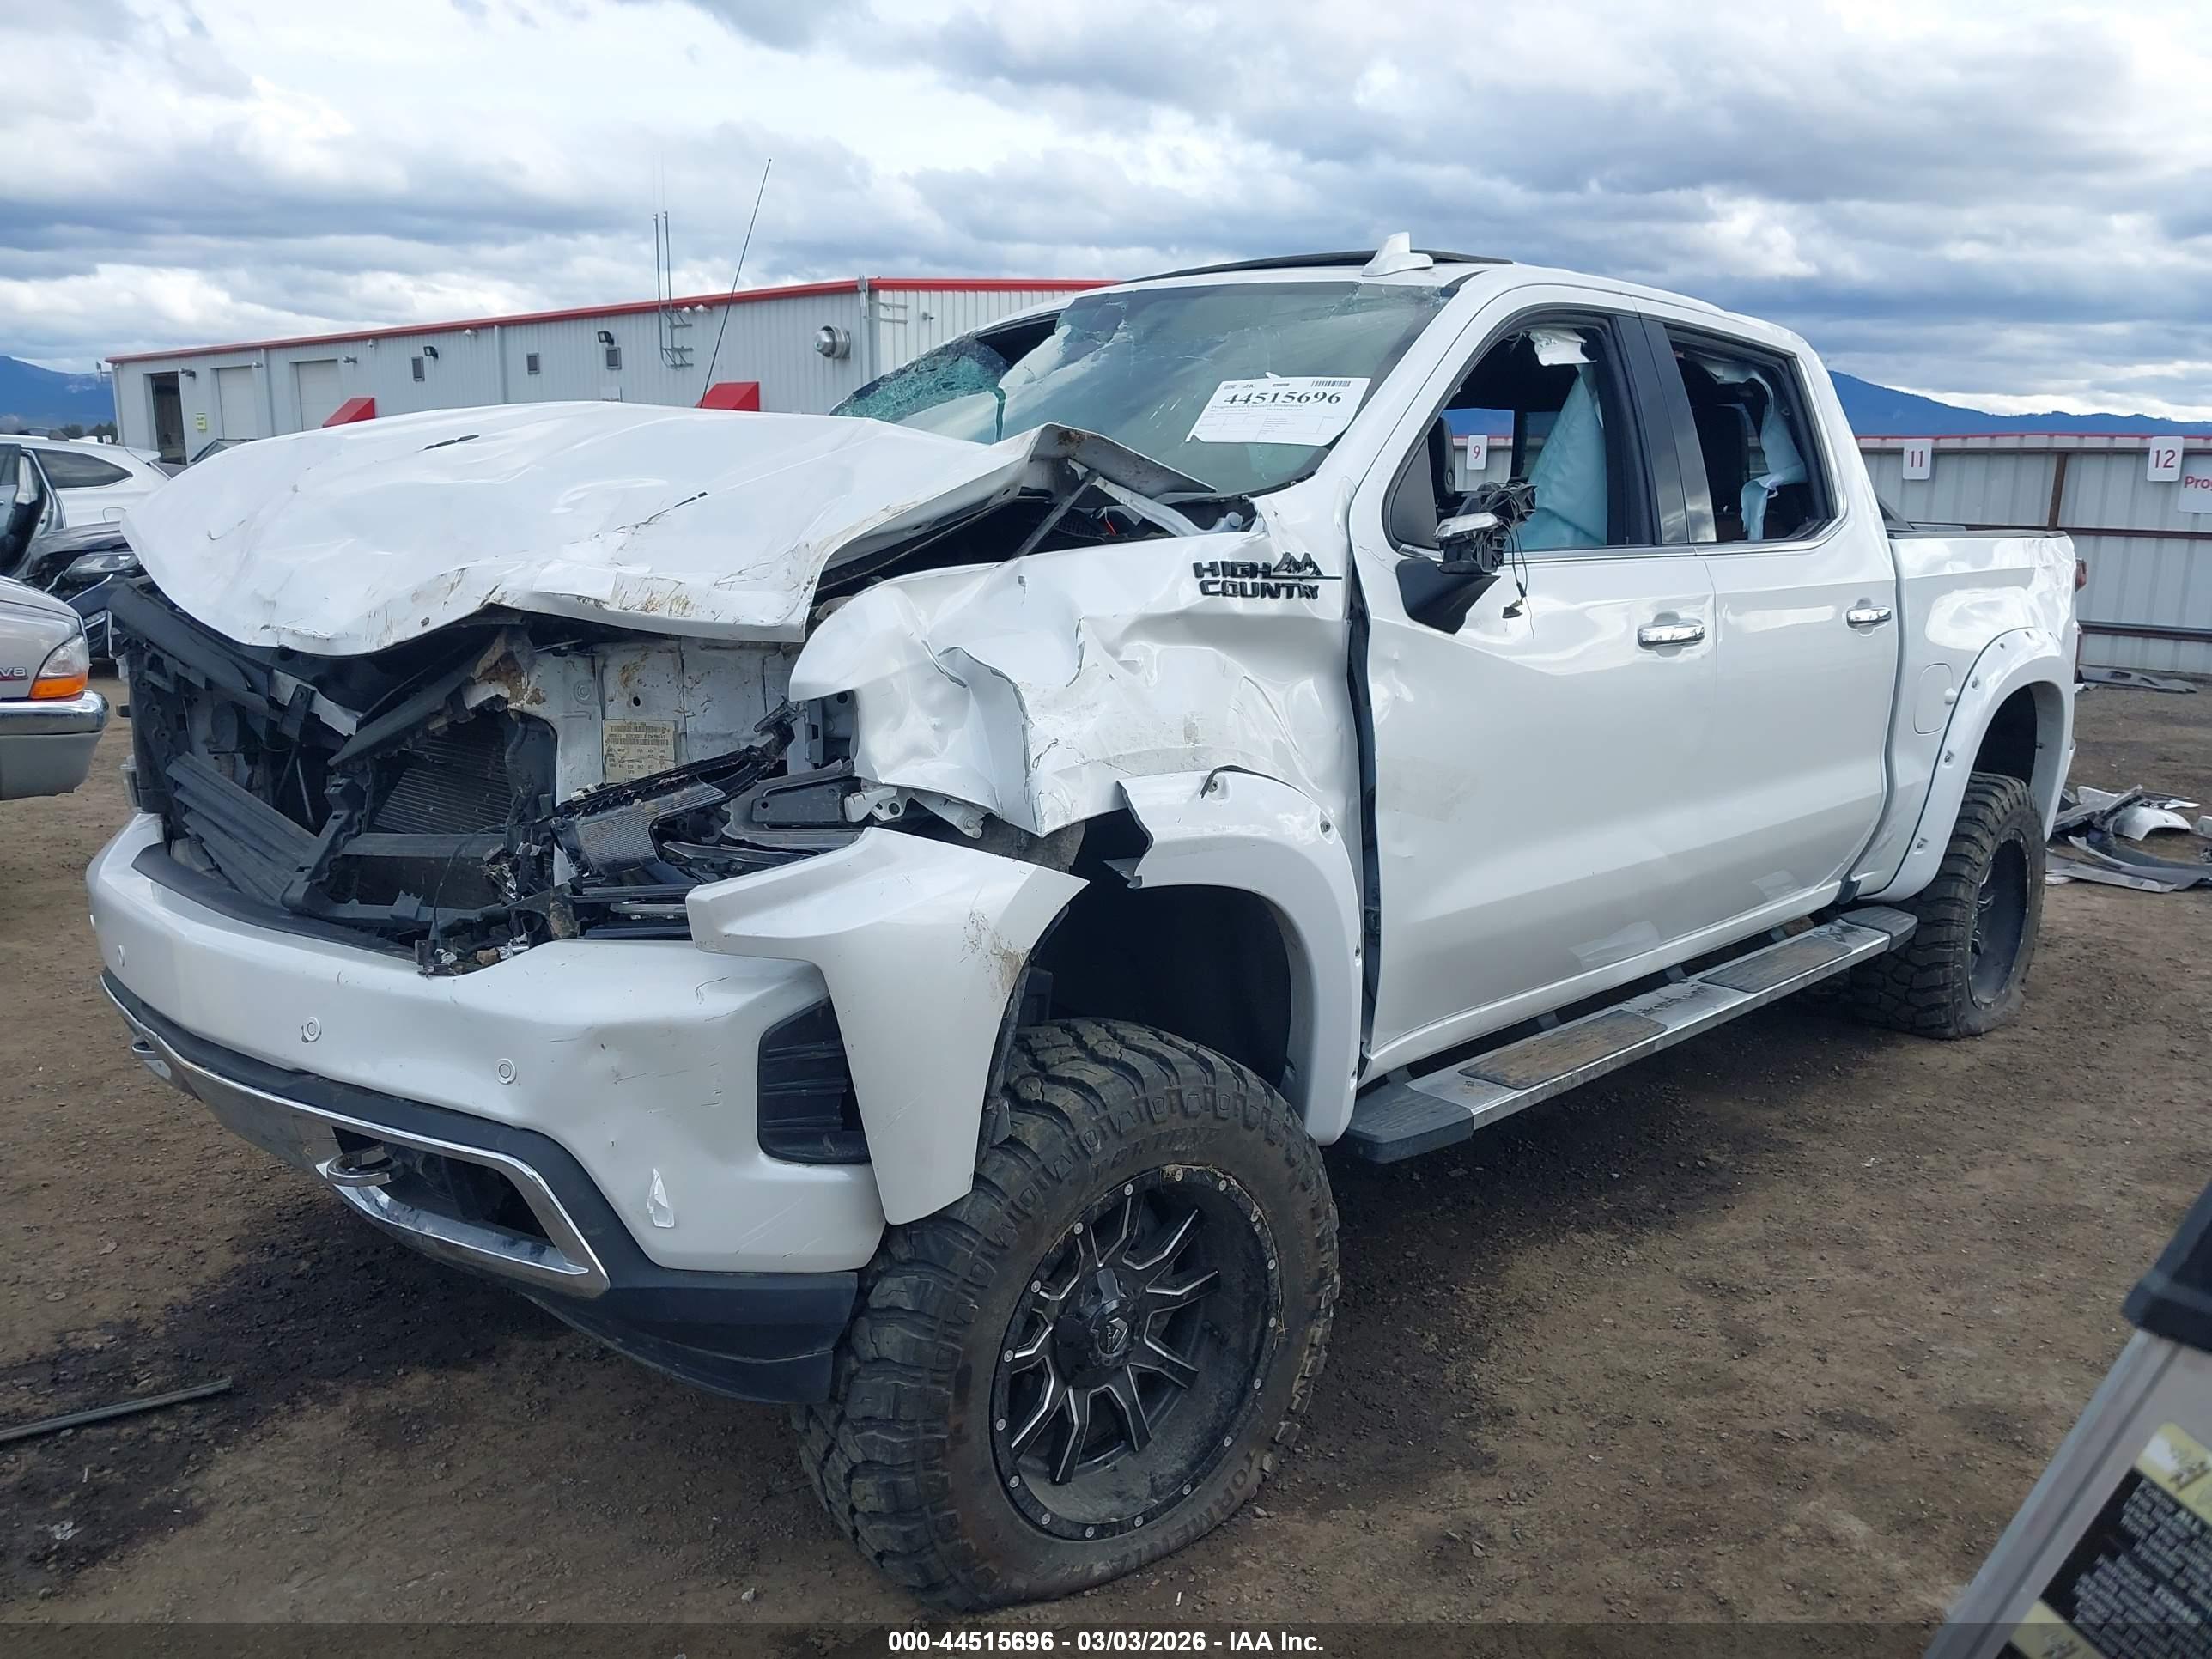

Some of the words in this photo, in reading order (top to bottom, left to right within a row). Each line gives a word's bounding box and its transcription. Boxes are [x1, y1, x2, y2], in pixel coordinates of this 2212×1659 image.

[1224, 392, 1343, 404] 44515696
[1474, 445, 1480, 459] 9
[1909, 450, 1924, 468] 11
[2154, 449, 2176, 469] 12
[1192, 561, 1273, 579] HIGH
[1199, 580, 1320, 599] COUNTRY
